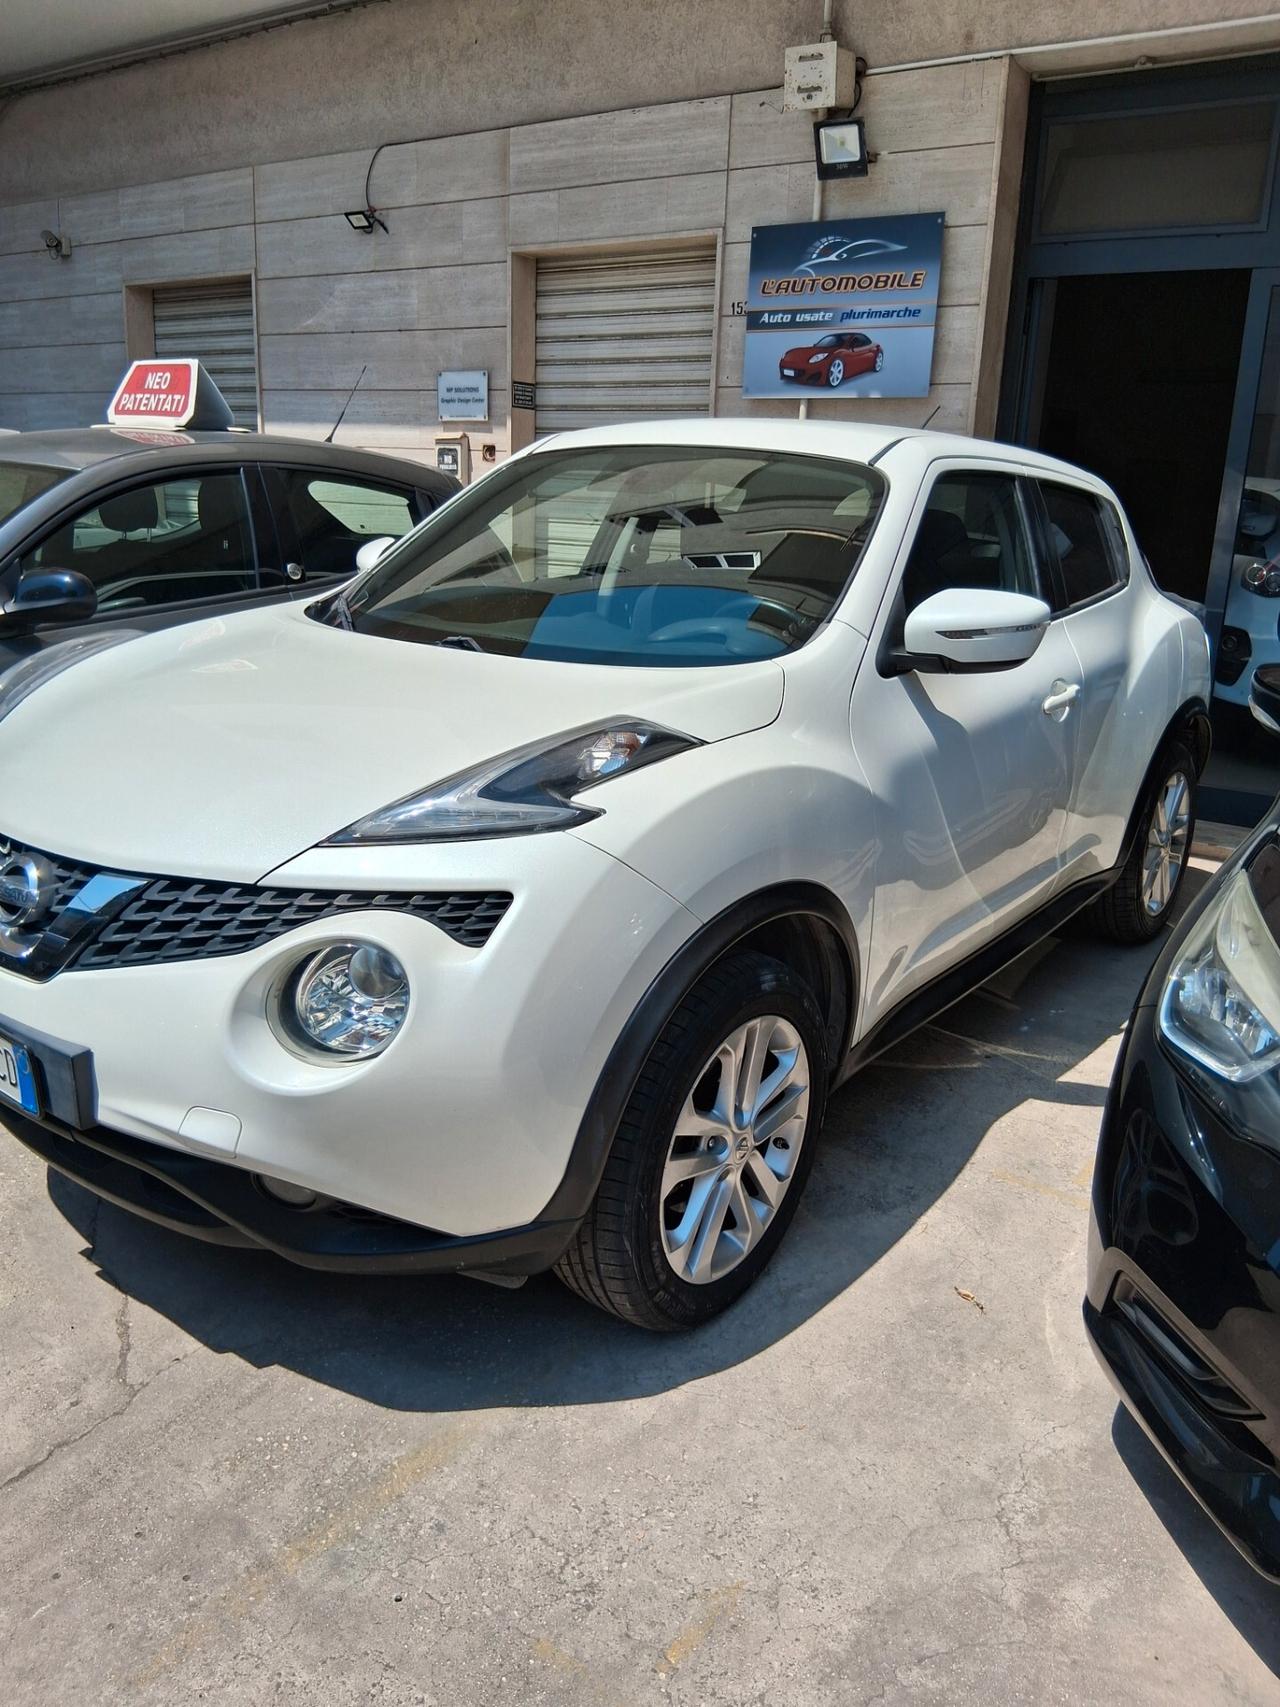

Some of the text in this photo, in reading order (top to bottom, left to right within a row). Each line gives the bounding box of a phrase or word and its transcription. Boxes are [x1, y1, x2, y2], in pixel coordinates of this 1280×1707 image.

[761, 271, 926, 298] L'AUTOMOBILE
[759, 307, 921, 324] Auto usate plurimarche
[144, 372, 171, 390] NEO
[118, 393, 186, 413] PATENTATI
